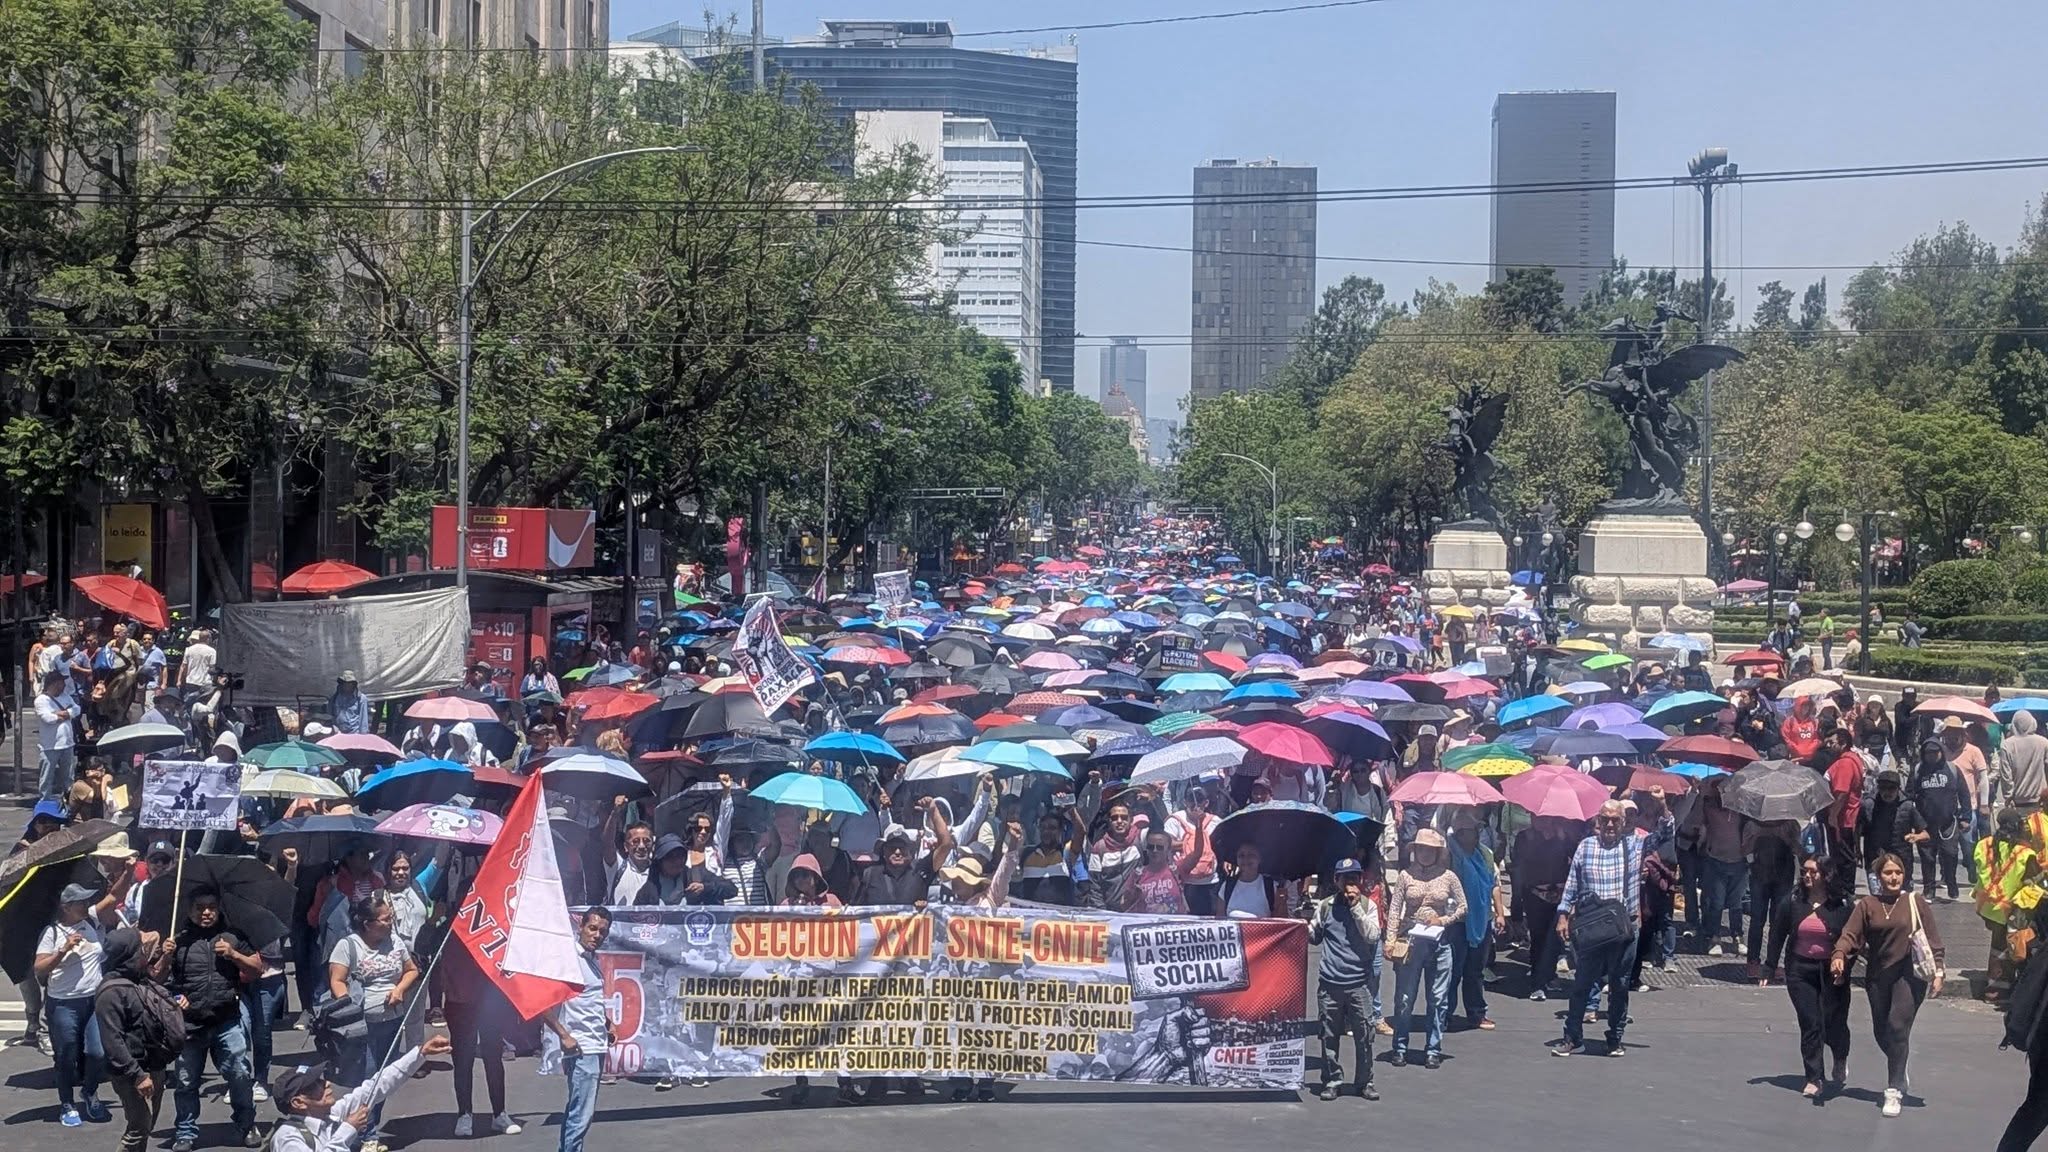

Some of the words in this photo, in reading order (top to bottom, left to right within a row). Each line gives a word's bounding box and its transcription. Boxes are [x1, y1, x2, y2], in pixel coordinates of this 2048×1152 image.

[494, 621, 514, 637] $10
[759, 664, 807, 702] OAXACA
[733, 911, 857, 958] SECCIÓN
[873, 917, 930, 957] XXII
[948, 917, 1107, 964] SNTE-CNTE
[1133, 931, 1152, 948] EN
[1155, 927, 1215, 946] DEFENSA
[1218, 925, 1236, 942] DE
[1135, 949, 1156, 966] LA
[1159, 942, 1237, 964] SEGURIDAD
[1154, 961, 1229, 987] SOCIAL
[679, 975, 791, 998] ¡ABROGACIÓN
[796, 979, 818, 998] DE
[823, 979, 843, 998] LA
[848, 978, 925, 998] REFORMA
[931, 978, 1020, 1001] EDUCATIVA
[1026, 979, 1129, 1005] PEÑA-AMLO!
[685, 1002, 731, 1022] ¡ALTO
[736, 1003, 747, 1022] A
[753, 1003, 773, 1022] LA
[779, 999, 923, 1022] CRIMINALIZACIÓN
[929, 1002, 949, 1022] DE
[956, 1003, 975, 1023] LA
[981, 1004, 1062, 1028] PROTESTA
[1068, 1008, 1132, 1030] SOCIAL!
[719, 1024, 830, 1047] ¡ABROGACIÓN
[835, 1026, 856, 1047] DE
[862, 1026, 882, 1047] LA
[888, 1026, 917, 1047] LEY
[923, 1026, 951, 1047] DEL
[957, 1028, 1013, 1050] ISSSTE
[1019, 1031, 1039, 1050] DE
[1045, 1032, 1096, 1053] 2007!
[766, 1051, 841, 1070] ¡SISTEMA
[846, 1051, 927, 1070] SOLIDARIO
[932, 1051, 951, 1070] DE
[957, 1052, 1048, 1073] PENSIONES!
[1214, 1047, 1257, 1065] CNTE
